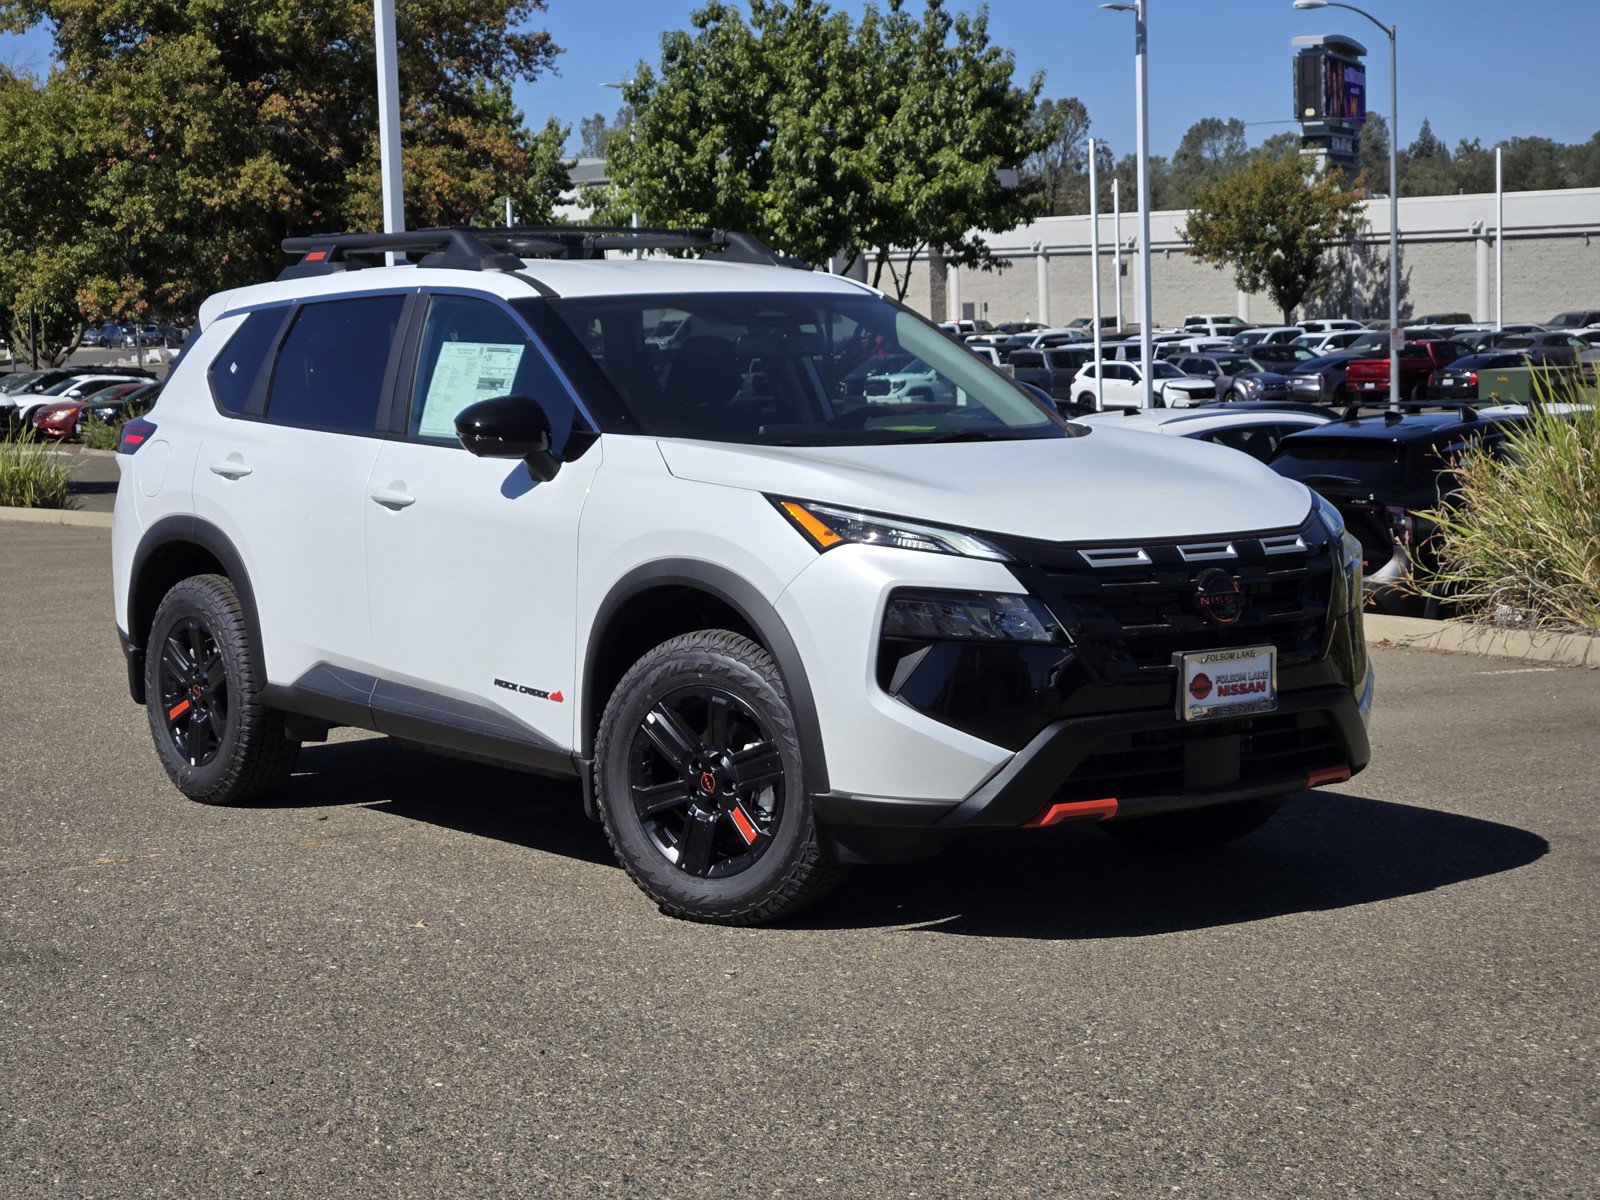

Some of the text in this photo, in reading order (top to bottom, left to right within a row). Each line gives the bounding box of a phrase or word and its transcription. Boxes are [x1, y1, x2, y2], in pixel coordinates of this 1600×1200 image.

[1206, 650, 1255, 662] FOLSOM LAKE
[1215, 670, 1269, 684] FOLSOM LAKE
[494, 678, 549, 699] ROCK CREEK
[1217, 681, 1267, 698] NISSAN
